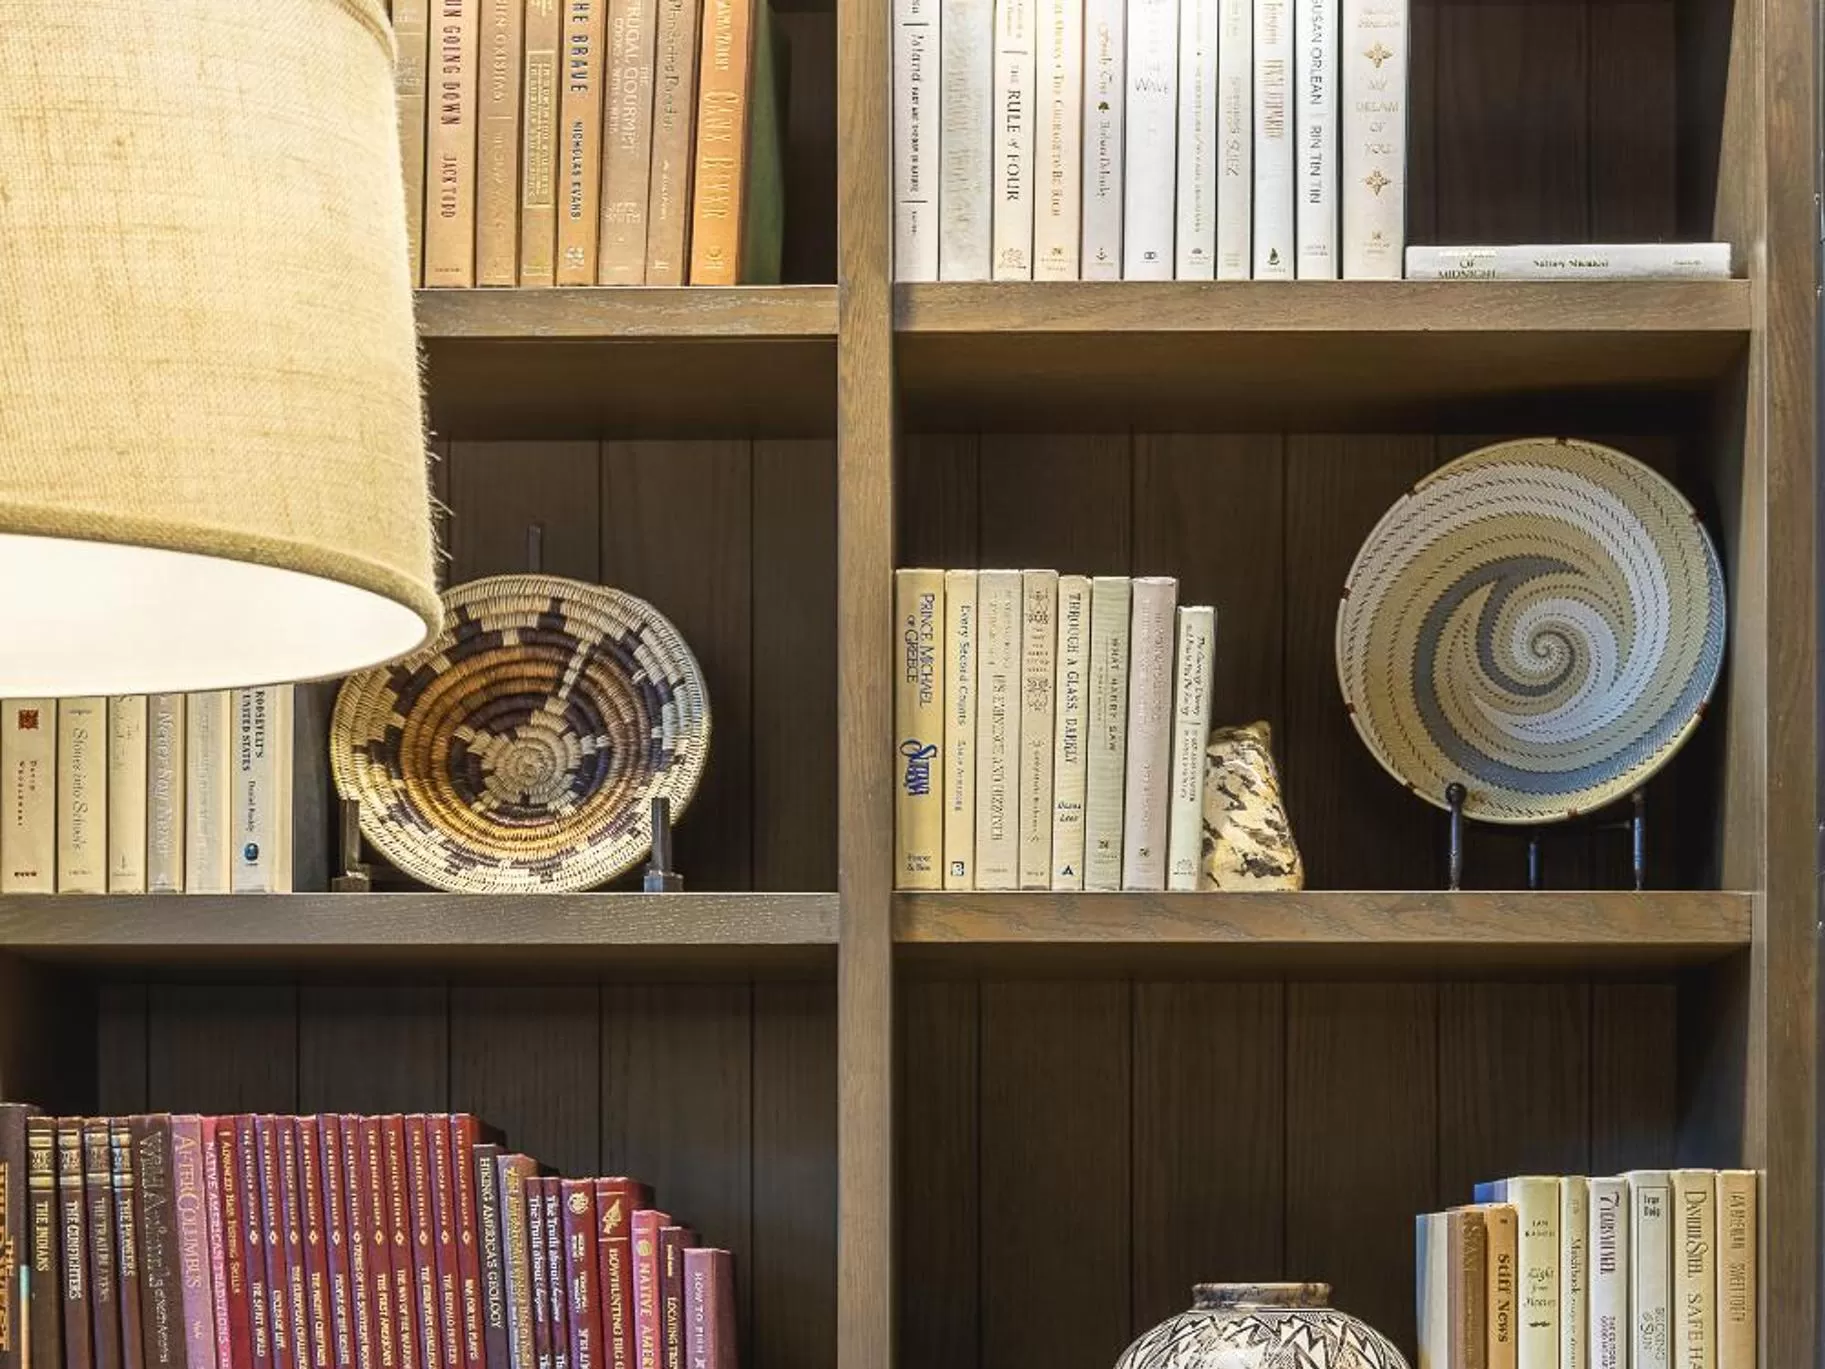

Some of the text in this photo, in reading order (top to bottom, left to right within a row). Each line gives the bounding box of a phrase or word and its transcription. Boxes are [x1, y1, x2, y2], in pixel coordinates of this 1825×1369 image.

[440, 26, 462, 126] GOING DOWN
[570, 36, 589, 92] BRAVE
[1309, 48, 1323, 106] ORLEAN
[618, 68, 639, 150] GOURMET
[1006, 89, 1022, 201] RULE FOUR
[440, 154, 458, 219] JACK TODD
[570, 121, 585, 219] NICHOLAS EVANS
[1309, 125, 1322, 204] RIN TIN TIN
[904, 630, 919, 684] GREECE
[918, 593, 936, 708] PRINCE MICHAEL
[1065, 593, 1081, 653] THROUGH
[957, 604, 971, 725] Every Second Counts
[241, 695, 252, 772] UNITED STATES
[255, 691, 266, 758] ROOSEVELT'S
[1063, 717, 1079, 764] DARKLY
[1108, 725, 1118, 752] SAW
[72, 728, 88, 851] Stones into Schools
[990, 755, 1004, 783] AND
[36, 1201, 50, 1271] THE INDIANS
[120, 1198, 136, 1277] THE PIONEERS
[140, 1131, 169, 1287] Wild Animals
[175, 1134, 201, 1288] AFTER COLUMBUS
[529, 1195, 545, 1281] The Truth about
[545, 1195, 561, 1281] The Truth about
[1599, 1192, 1620, 1207] 7
[66, 1200, 82, 1300] THE GUNFIGHTERS
[94, 1198, 110, 1302] THE TRAILBLAZERS
[206, 1140, 229, 1345] NATIVE AMERICAN TRADITIONS
[229, 1261, 241, 1294] SKILLS
[478, 1158, 501, 1330] HIKING AMERICA'S GEOLOGY
[608, 1248, 625, 1360] BOWHUNTING BIG
[639, 1262, 653, 1317] NATIVE
[665, 1297, 679, 1344] LOCATING
[692, 1272, 704, 1322] HOW TO
[1496, 1253, 1512, 1343] Stiff News
[1687, 1293, 1702, 1340] SAFE
